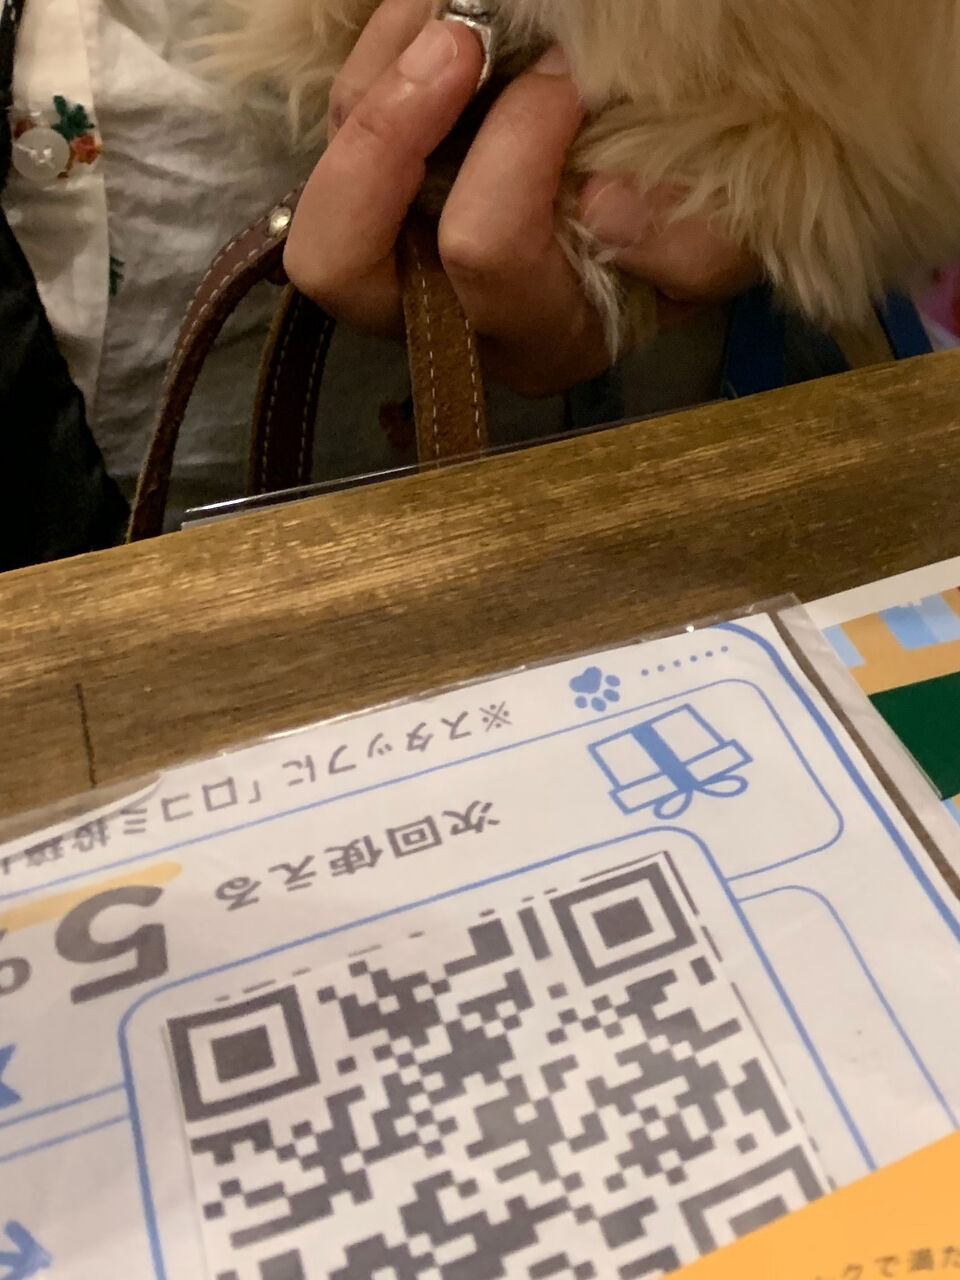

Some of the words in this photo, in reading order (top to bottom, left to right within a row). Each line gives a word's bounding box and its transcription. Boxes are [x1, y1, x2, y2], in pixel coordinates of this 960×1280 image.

[215, 800, 500, 912] 次回使える
